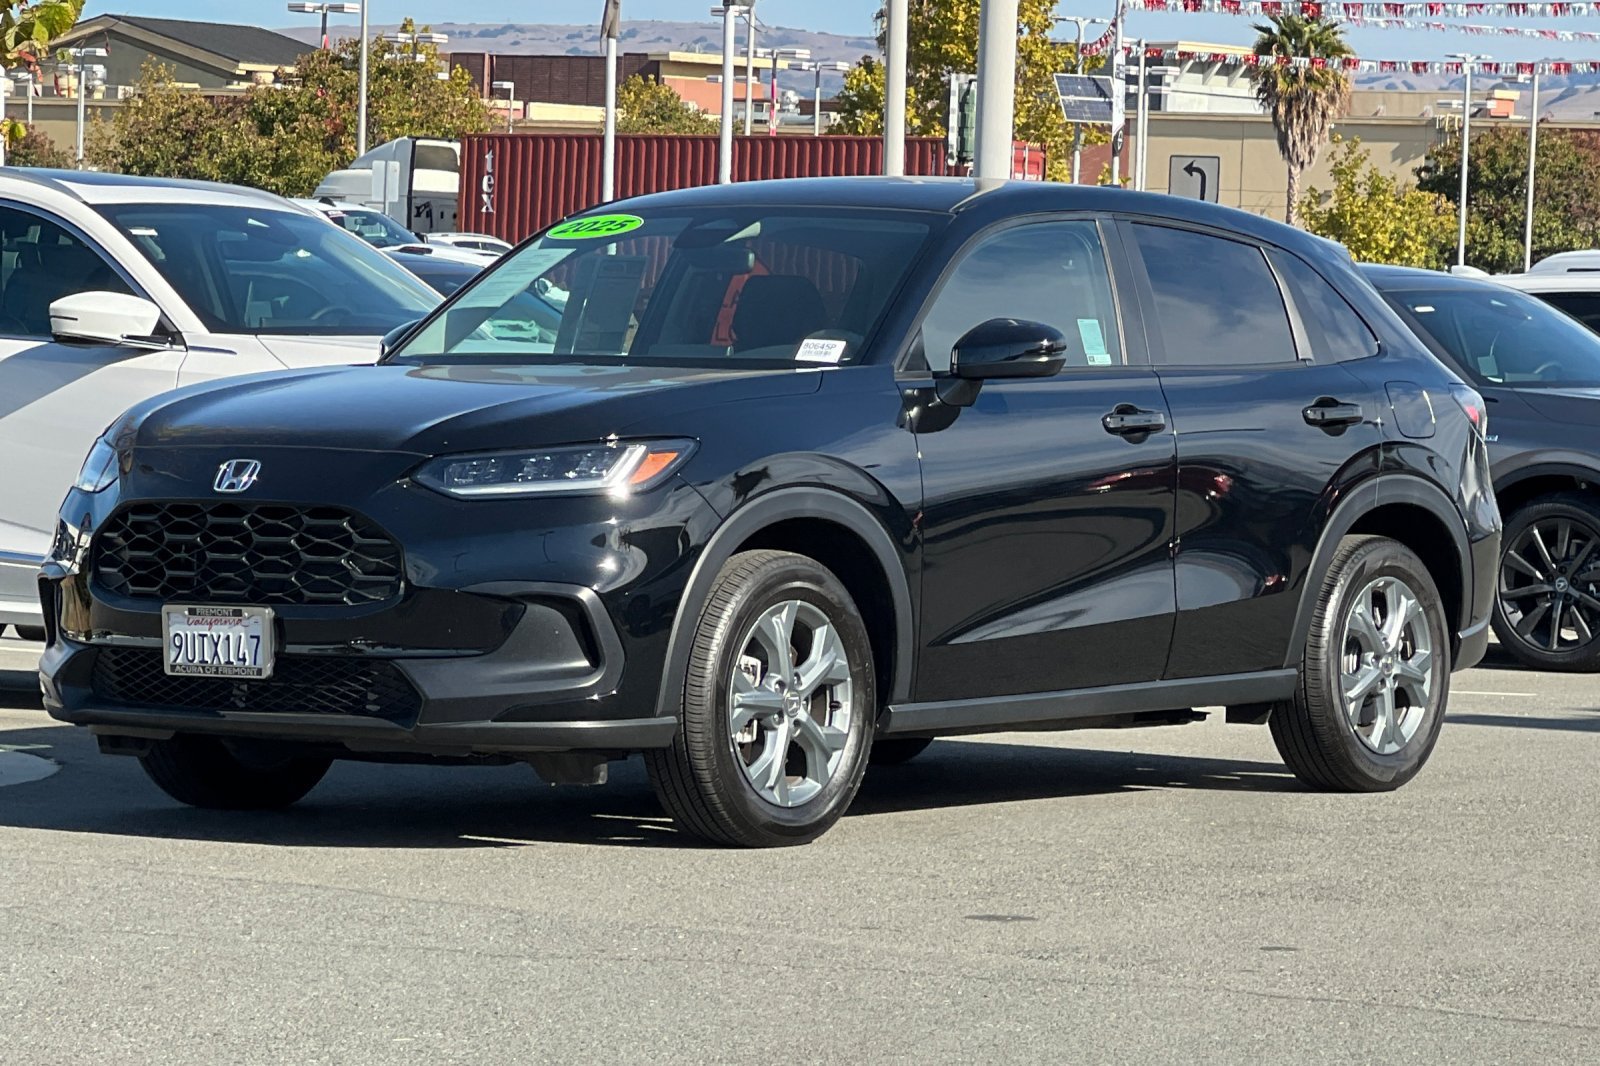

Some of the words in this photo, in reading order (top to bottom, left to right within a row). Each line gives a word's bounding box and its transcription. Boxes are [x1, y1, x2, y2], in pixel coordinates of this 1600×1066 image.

[481, 149, 494, 213] tex
[552, 219, 637, 235] 2025
[196, 608, 234, 616] FREMONT
[187, 617, 246, 631] California
[172, 632, 261, 666] 9UIX147
[174, 665, 204, 674] ACURA
[204, 666, 217, 674] OF
[218, 666, 258, 675] FREMONT
